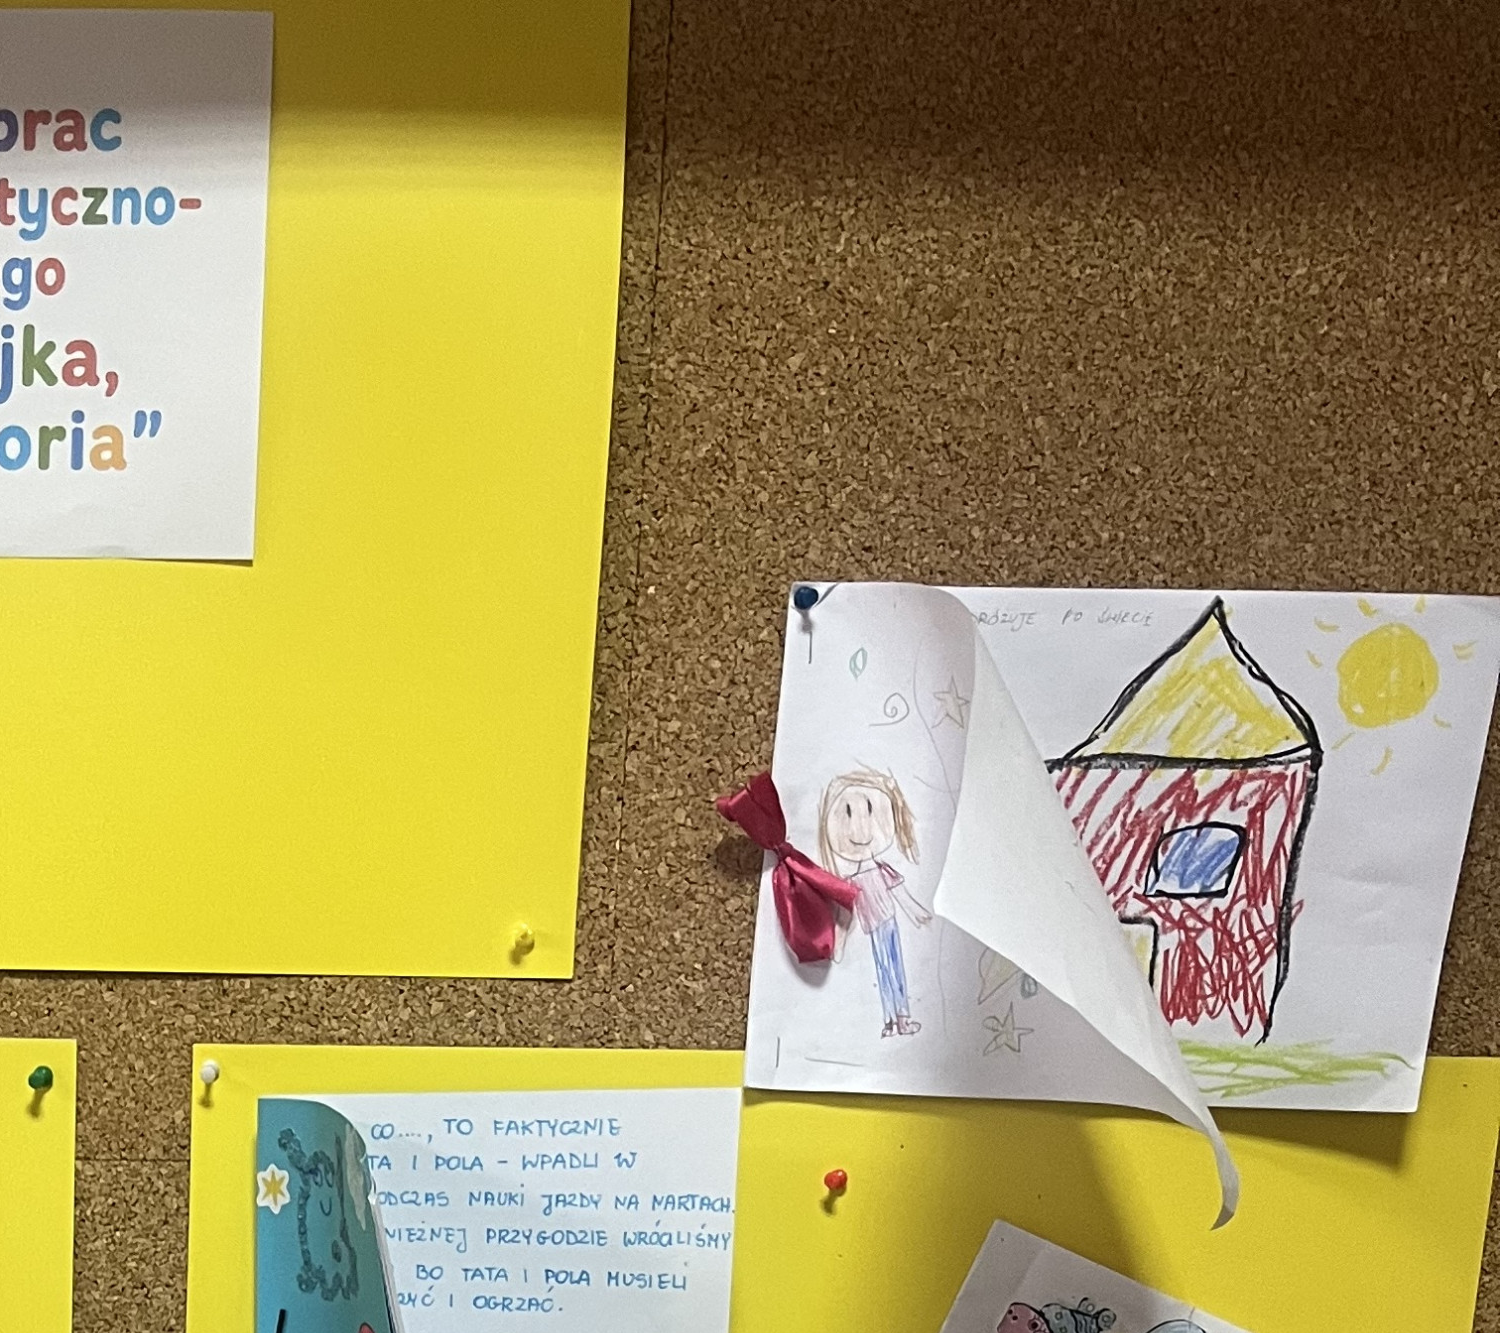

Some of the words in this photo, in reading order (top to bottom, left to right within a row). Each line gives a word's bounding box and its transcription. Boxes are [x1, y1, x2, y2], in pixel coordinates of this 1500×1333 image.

[444, 1119, 474, 1136] TO
[493, 1119, 621, 1137] FAKTYCZNIE
[412, 1155, 417, 1171] I
[434, 1155, 483, 1171] POLA
[522, 1153, 598, 1169] WPADLI
[615, 1152, 637, 1170] W
[469, 1184, 525, 1207] NAUKI
[541, 1192, 604, 1216] JAZDY
[615, 1193, 640, 1210] NA
[486, 1229, 608, 1248] PRZYGODZIE
[416, 1265, 443, 1280] BO
[462, 1266, 508, 1283] TATA
[523, 1268, 527, 1283] I
[544, 1269, 591, 1287] POLA
[607, 1271, 687, 1291] MUSIELI
[449, 1294, 453, 1308] I
